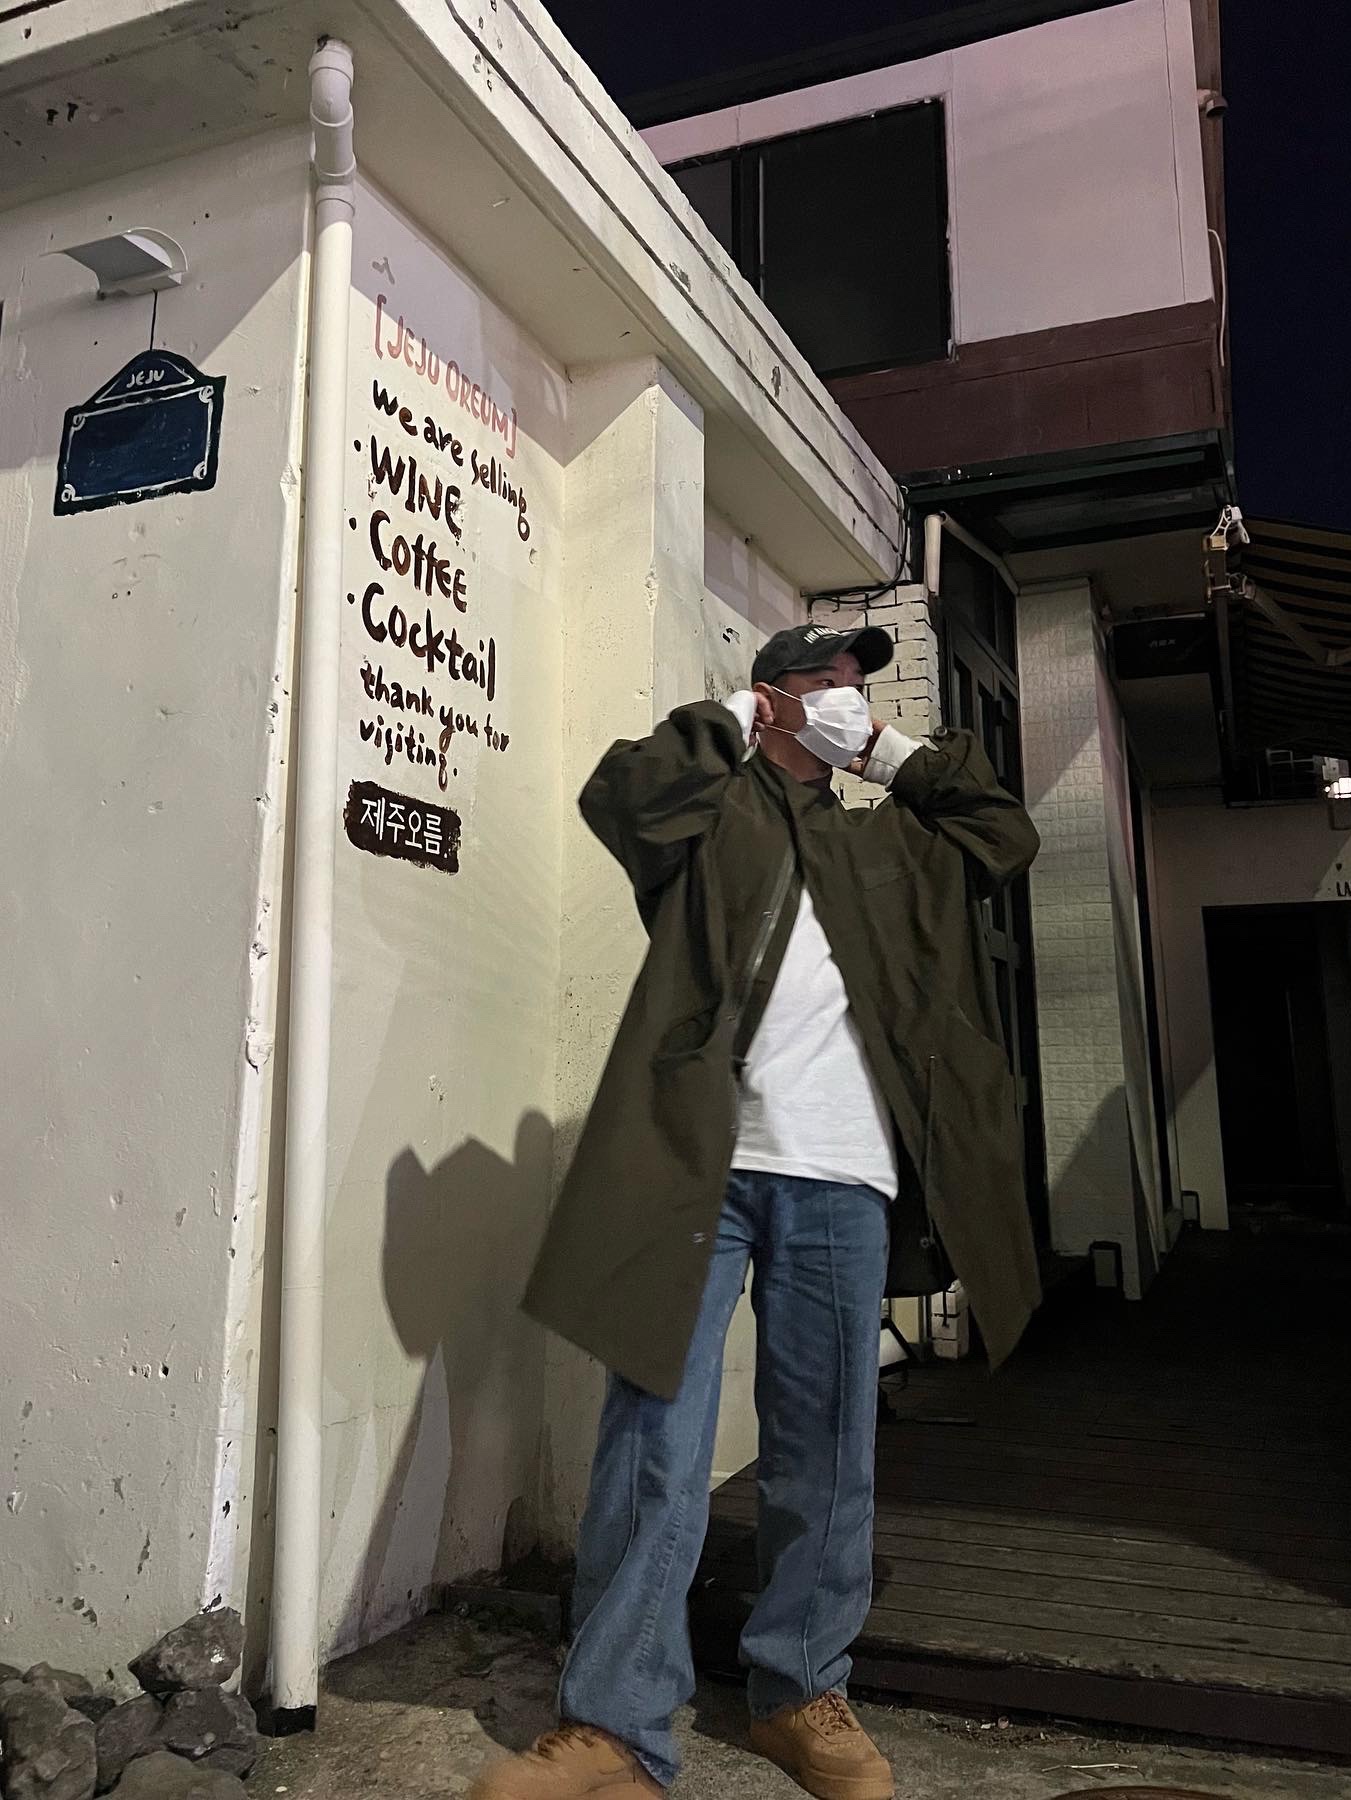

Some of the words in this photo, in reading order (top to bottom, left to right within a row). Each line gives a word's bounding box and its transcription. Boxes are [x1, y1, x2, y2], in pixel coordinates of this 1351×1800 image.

[126, 369, 165, 389] JEJU
[424, 416, 464, 467] are
[371, 435, 463, 541] WINE
[362, 582, 496, 702] Cocktail
[360, 663, 434, 717] thank
[439, 705, 478, 753] you
